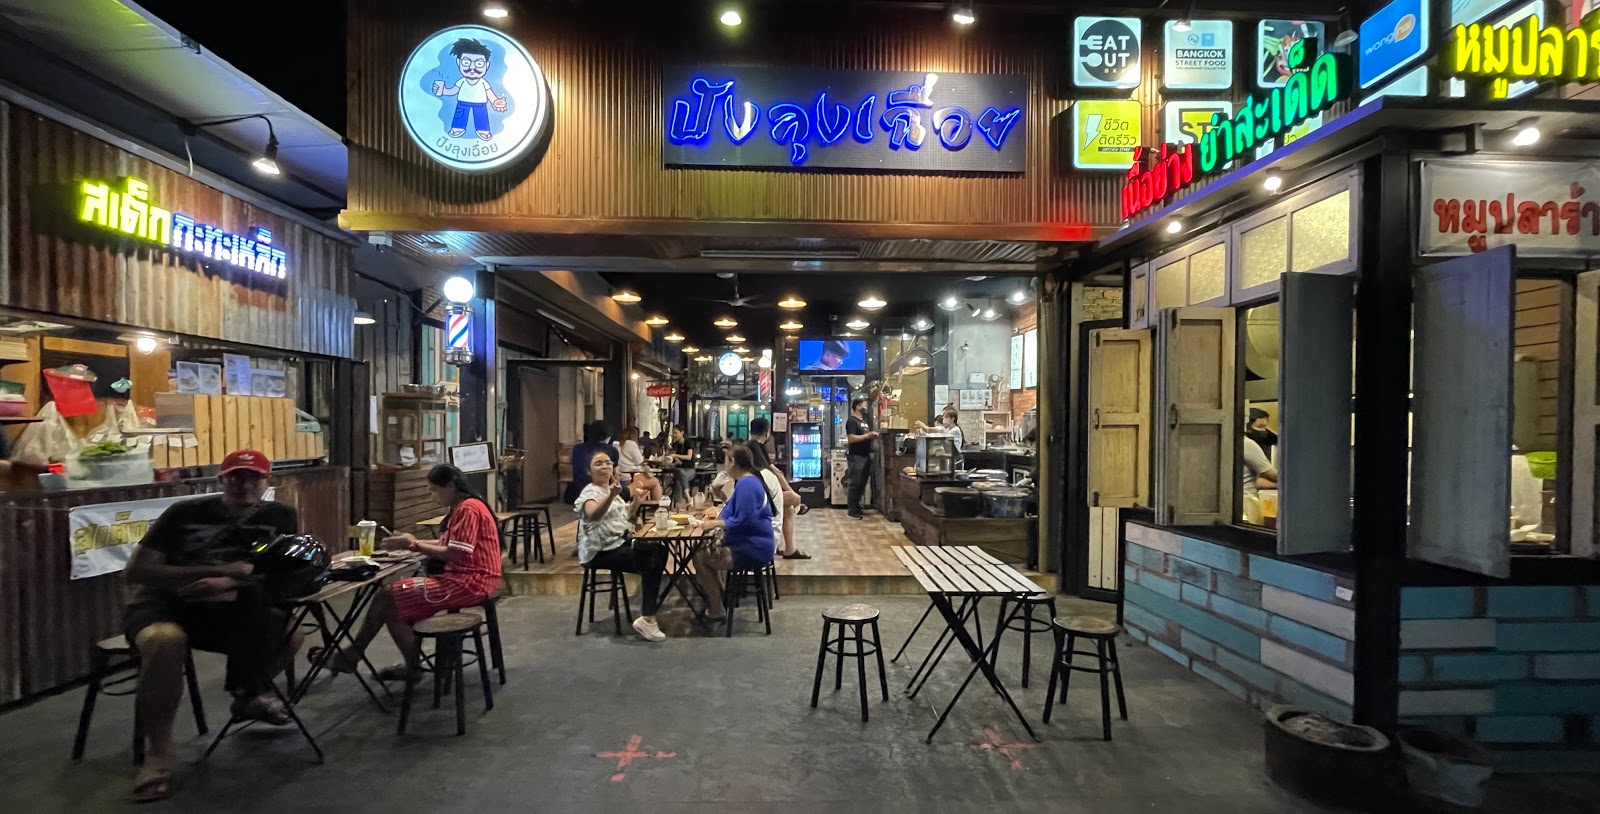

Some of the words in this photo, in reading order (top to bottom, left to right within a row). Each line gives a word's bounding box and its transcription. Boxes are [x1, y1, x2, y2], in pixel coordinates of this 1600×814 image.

[1086, 35, 1131, 50] EAT
[1176, 49, 1224, 58] BANGKOK
[1175, 59, 1203, 67] STREET
[1204, 59, 1227, 67] FOOD
[669, 72, 1021, 165] ปังลุงเฉื่อย
[1103, 117, 1129, 131] ชีวิต
[436, 135, 499, 158] ปังลุงเฉื่อย
[1098, 133, 1137, 146] ติดรีวิว
[1121, 142, 1194, 219] เนื้อย่าง
[79, 176, 171, 246] สเต็ก
